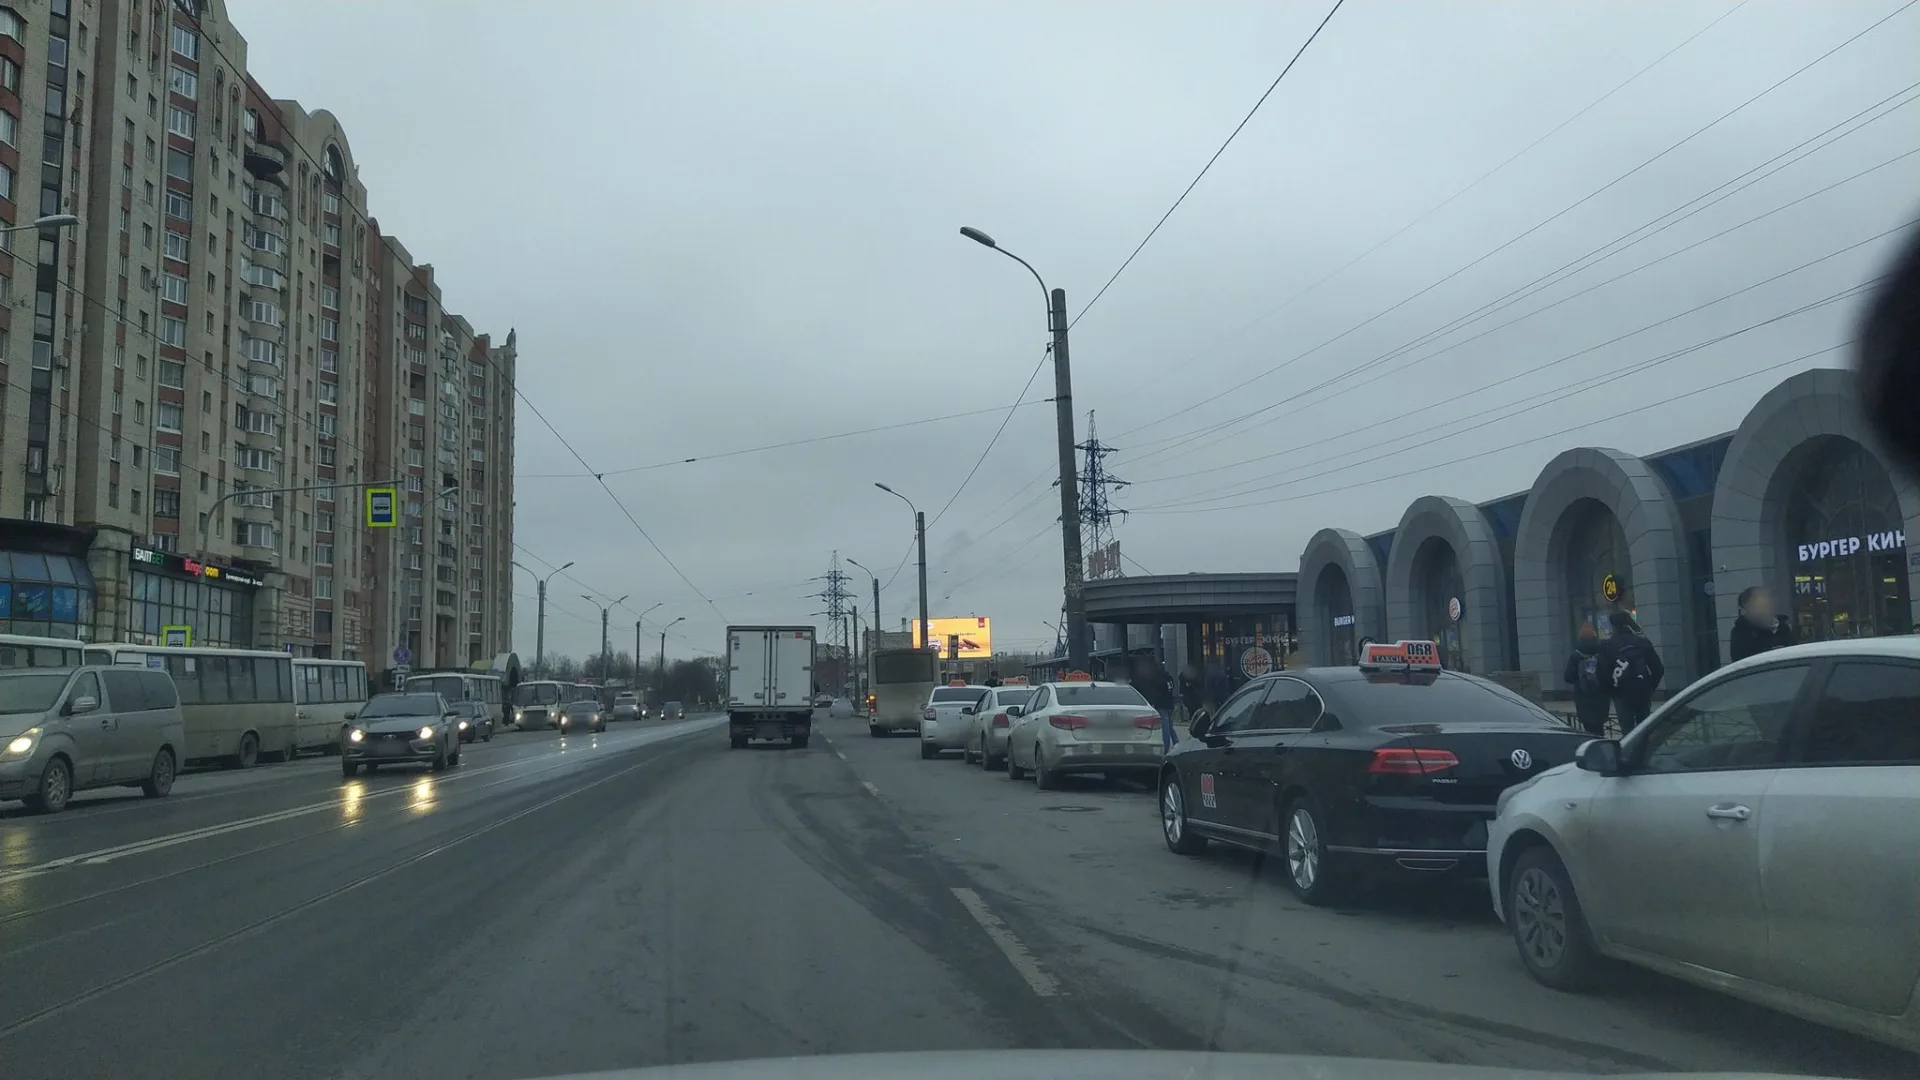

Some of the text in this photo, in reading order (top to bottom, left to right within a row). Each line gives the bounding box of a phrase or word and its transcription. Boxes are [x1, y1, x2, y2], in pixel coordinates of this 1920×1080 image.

[1798, 537, 1860, 562] БУРГЕР
[1606, 580, 1617, 595] 24
[1407, 643, 1432, 655] 068
